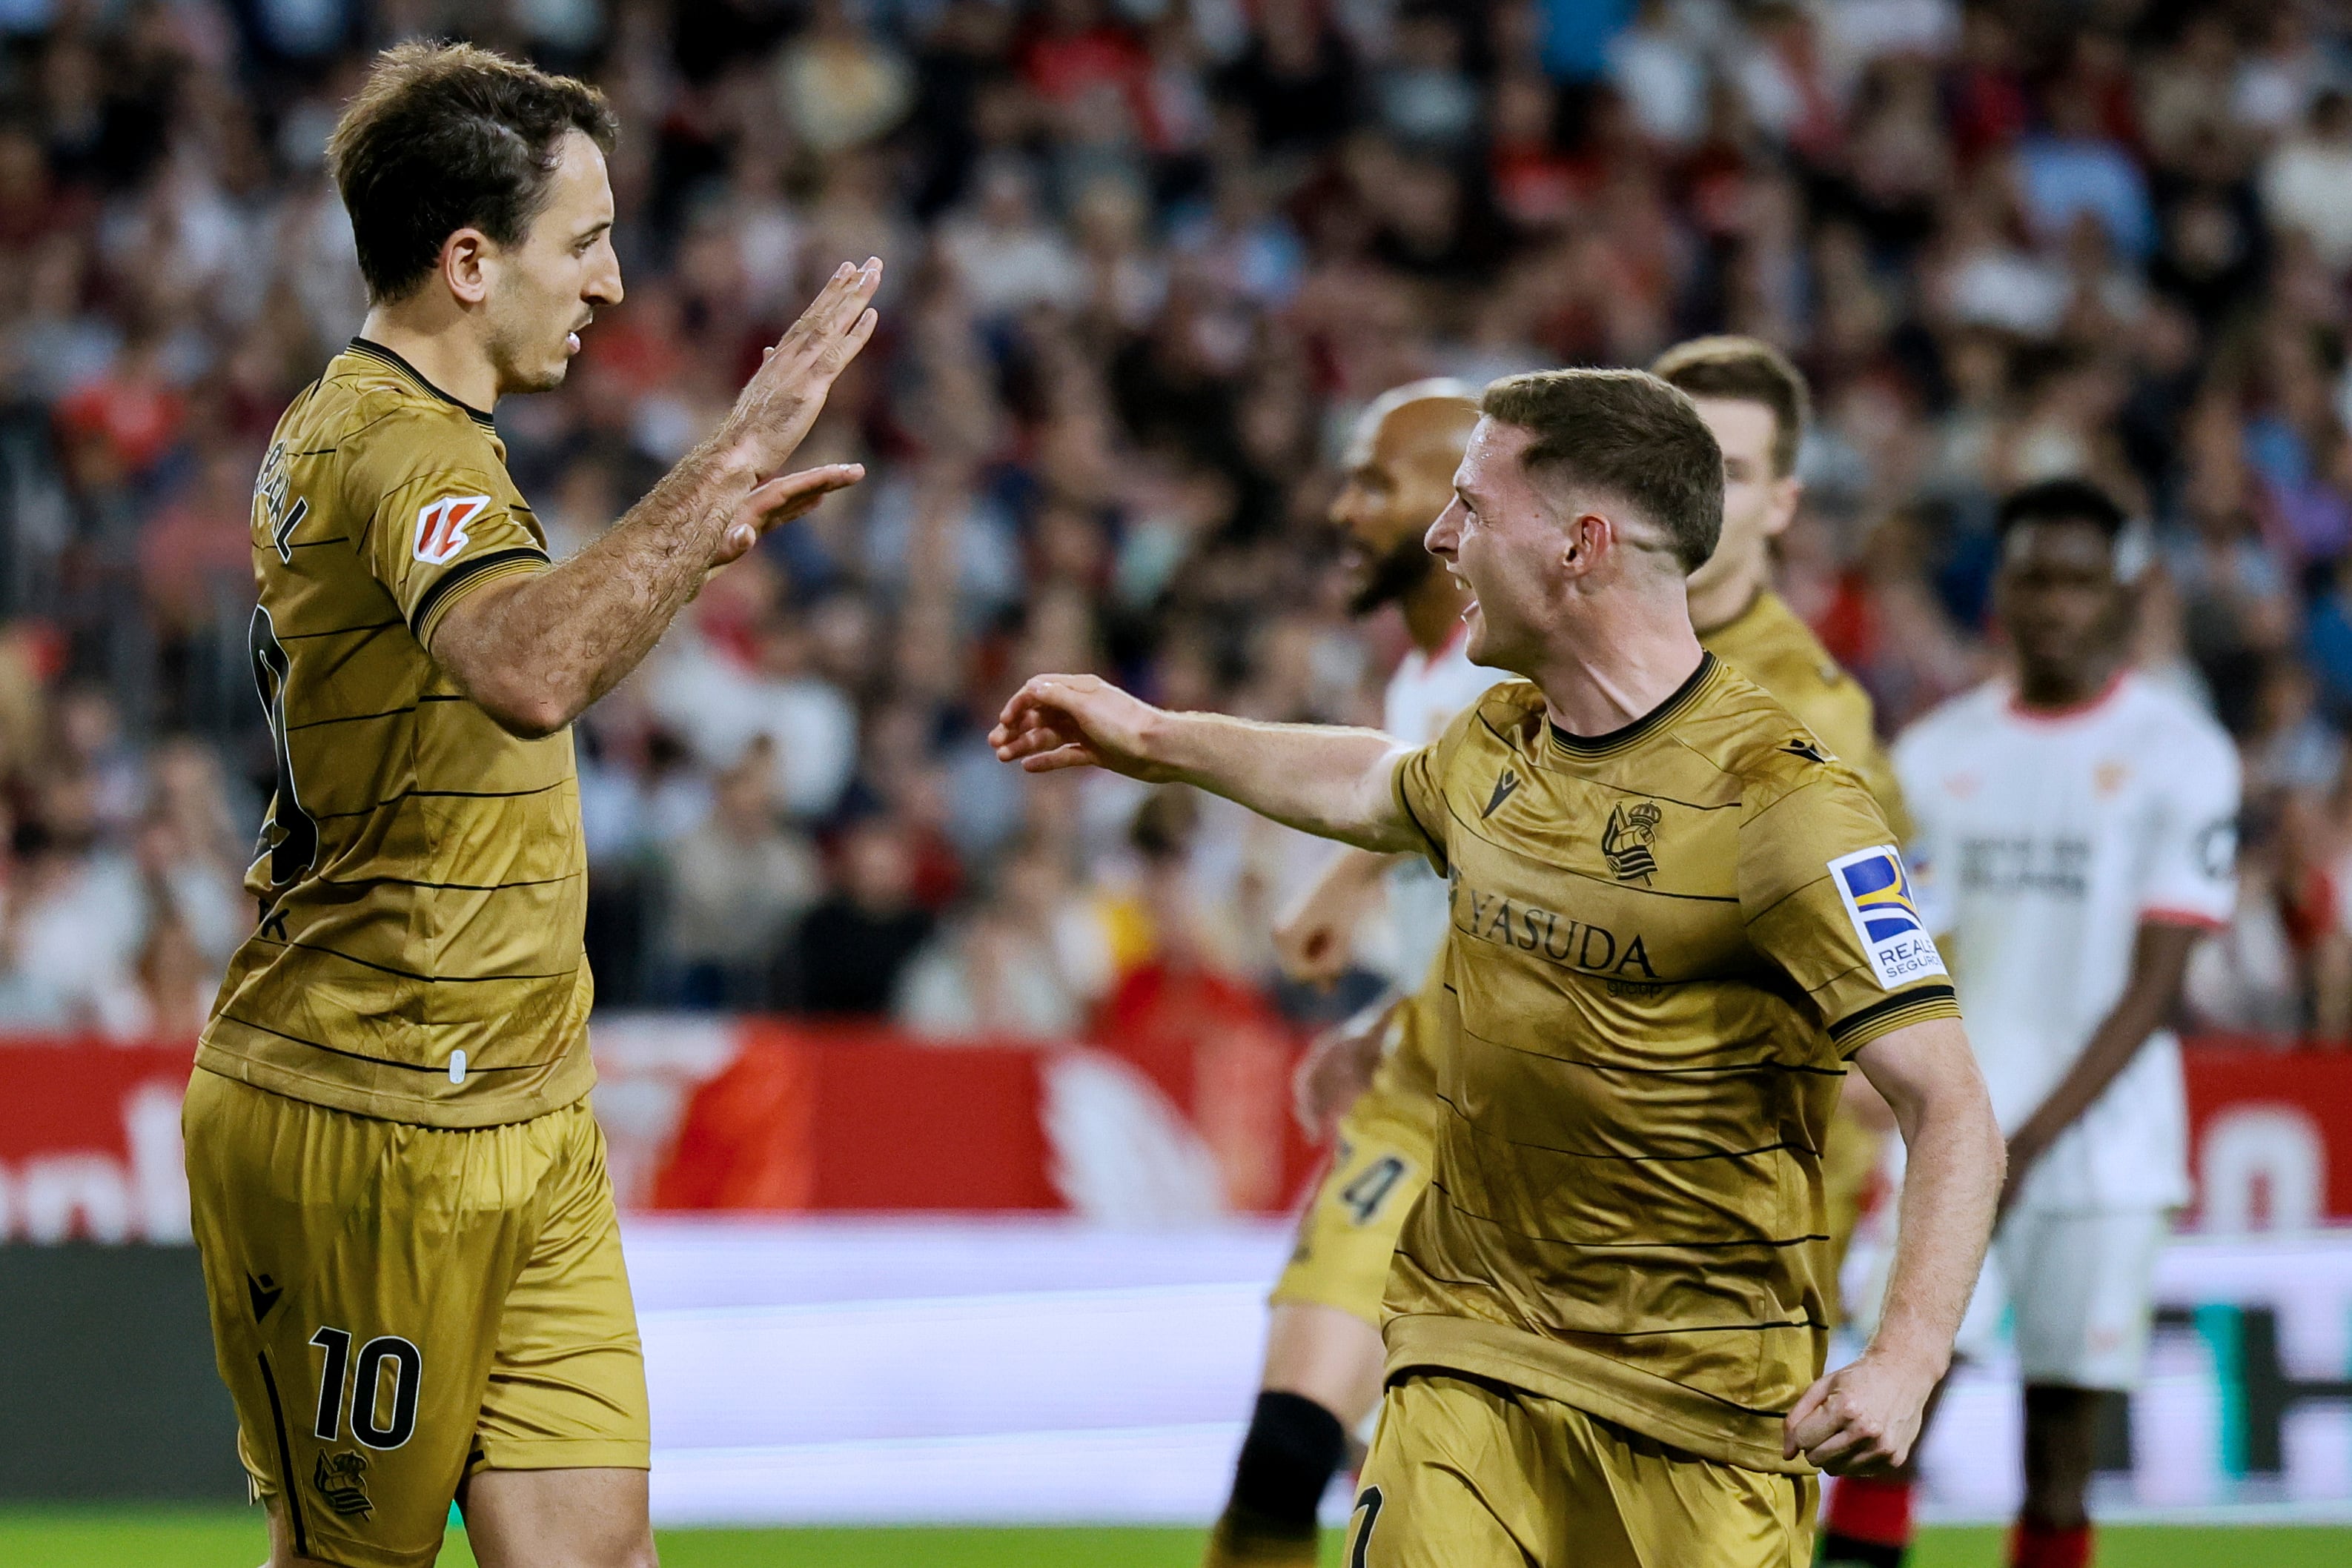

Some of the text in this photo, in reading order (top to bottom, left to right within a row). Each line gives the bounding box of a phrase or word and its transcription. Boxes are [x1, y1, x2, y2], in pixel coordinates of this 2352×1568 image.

[1470, 888, 1663, 979] YASUDA
[1878, 939, 1936, 966] REALE
[308, 1324, 422, 1451] 10
